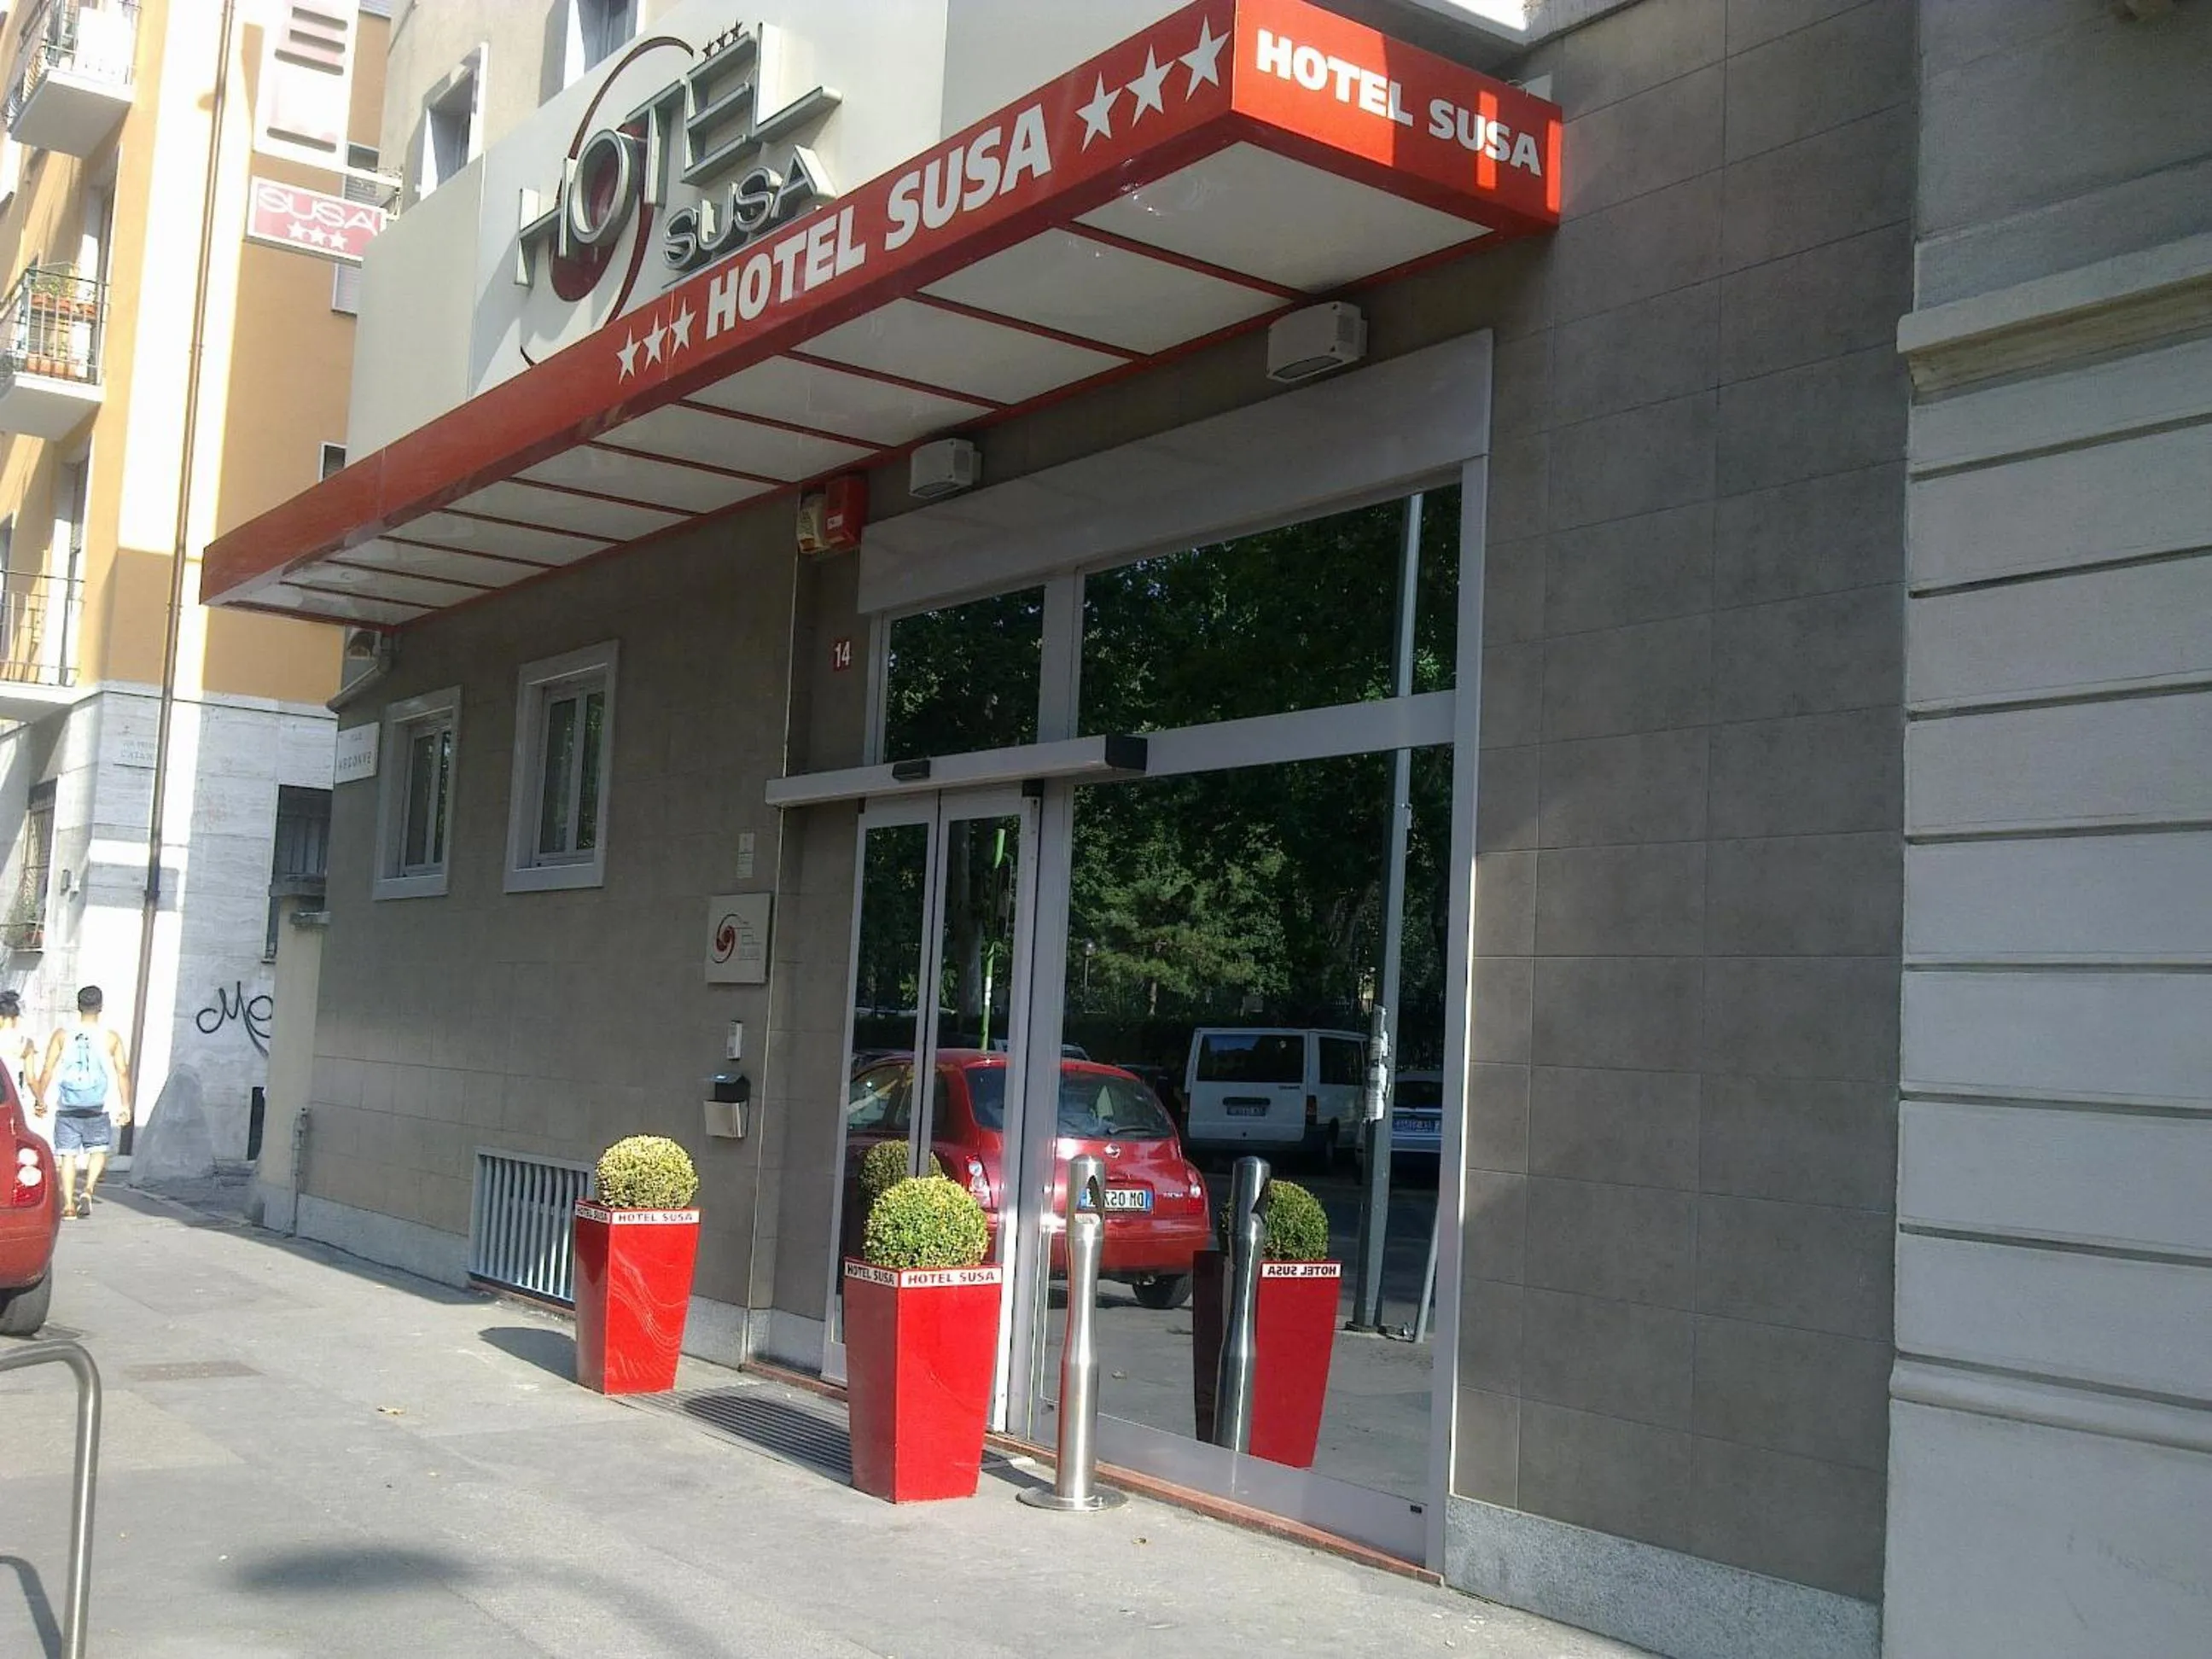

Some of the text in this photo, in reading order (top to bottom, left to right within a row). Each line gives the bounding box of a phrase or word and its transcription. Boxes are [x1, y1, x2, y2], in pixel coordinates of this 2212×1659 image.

[1256, 28, 1542, 176] HOTEL SUSA
[514, 21, 843, 287] HOTEL
[258, 183, 379, 236] SUSA
[663, 144, 838, 271] SUSA
[706, 103, 1051, 341] HOTEL SUSA
[835, 641, 851, 668] 14
[618, 1212, 693, 1222] HOTEL SUSA
[847, 1263, 895, 1285] HOTEL SUSA
[907, 1270, 995, 1285] HOTEL SUSA
